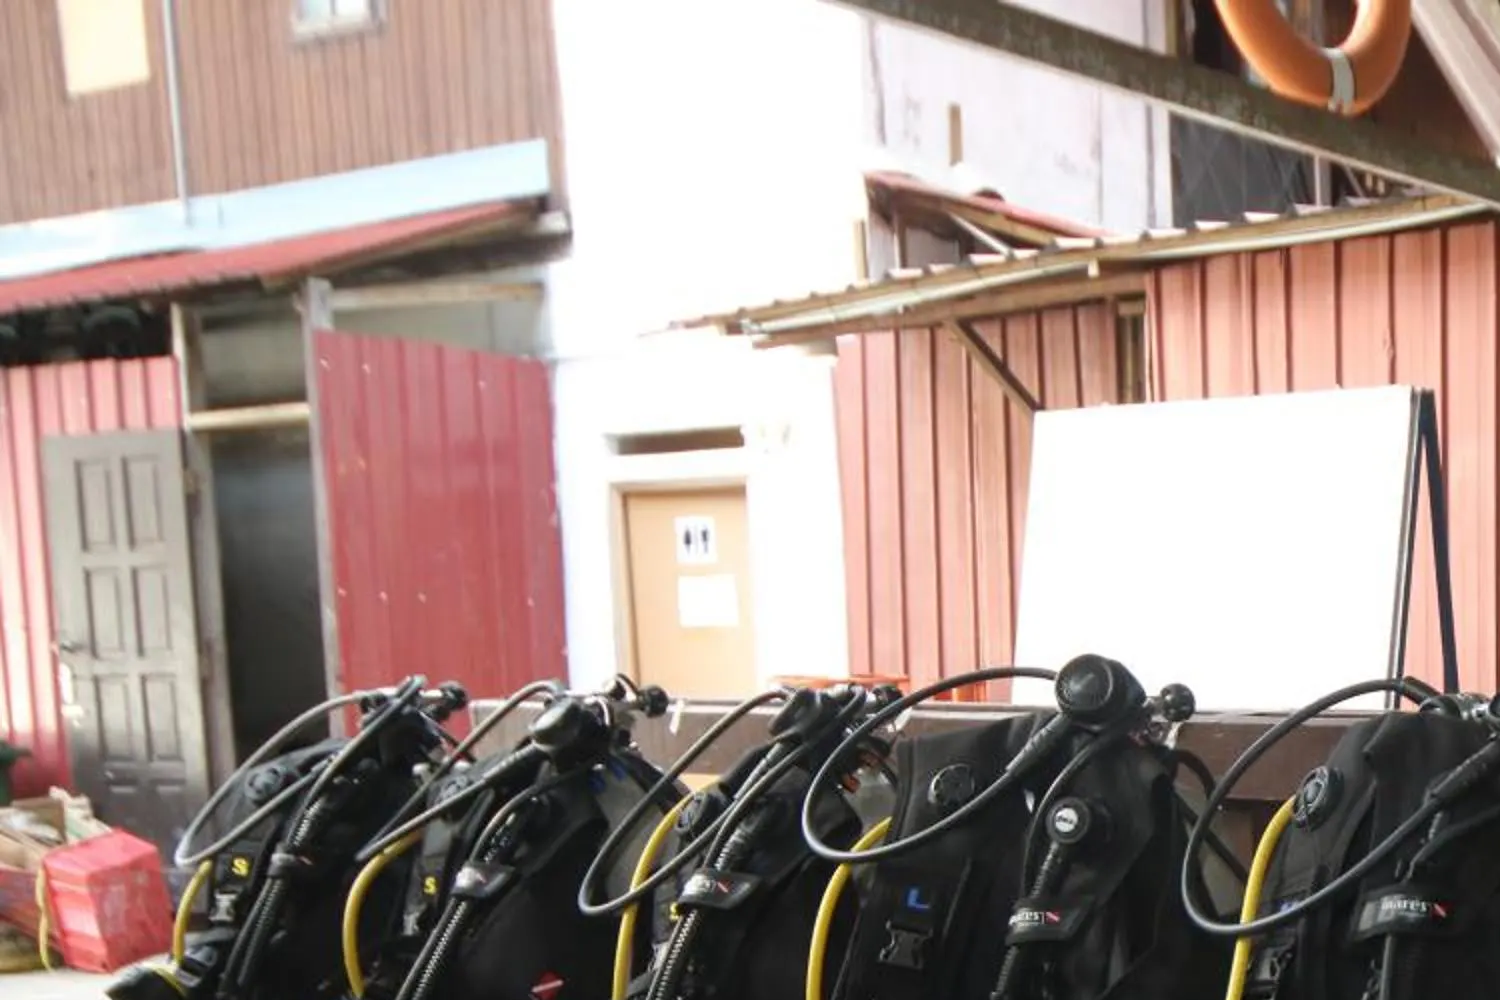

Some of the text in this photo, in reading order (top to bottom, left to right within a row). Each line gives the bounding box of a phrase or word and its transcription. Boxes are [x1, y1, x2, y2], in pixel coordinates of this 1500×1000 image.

[232, 857, 249, 877] S
[424, 876, 437, 895] S
[907, 888, 930, 909] L
